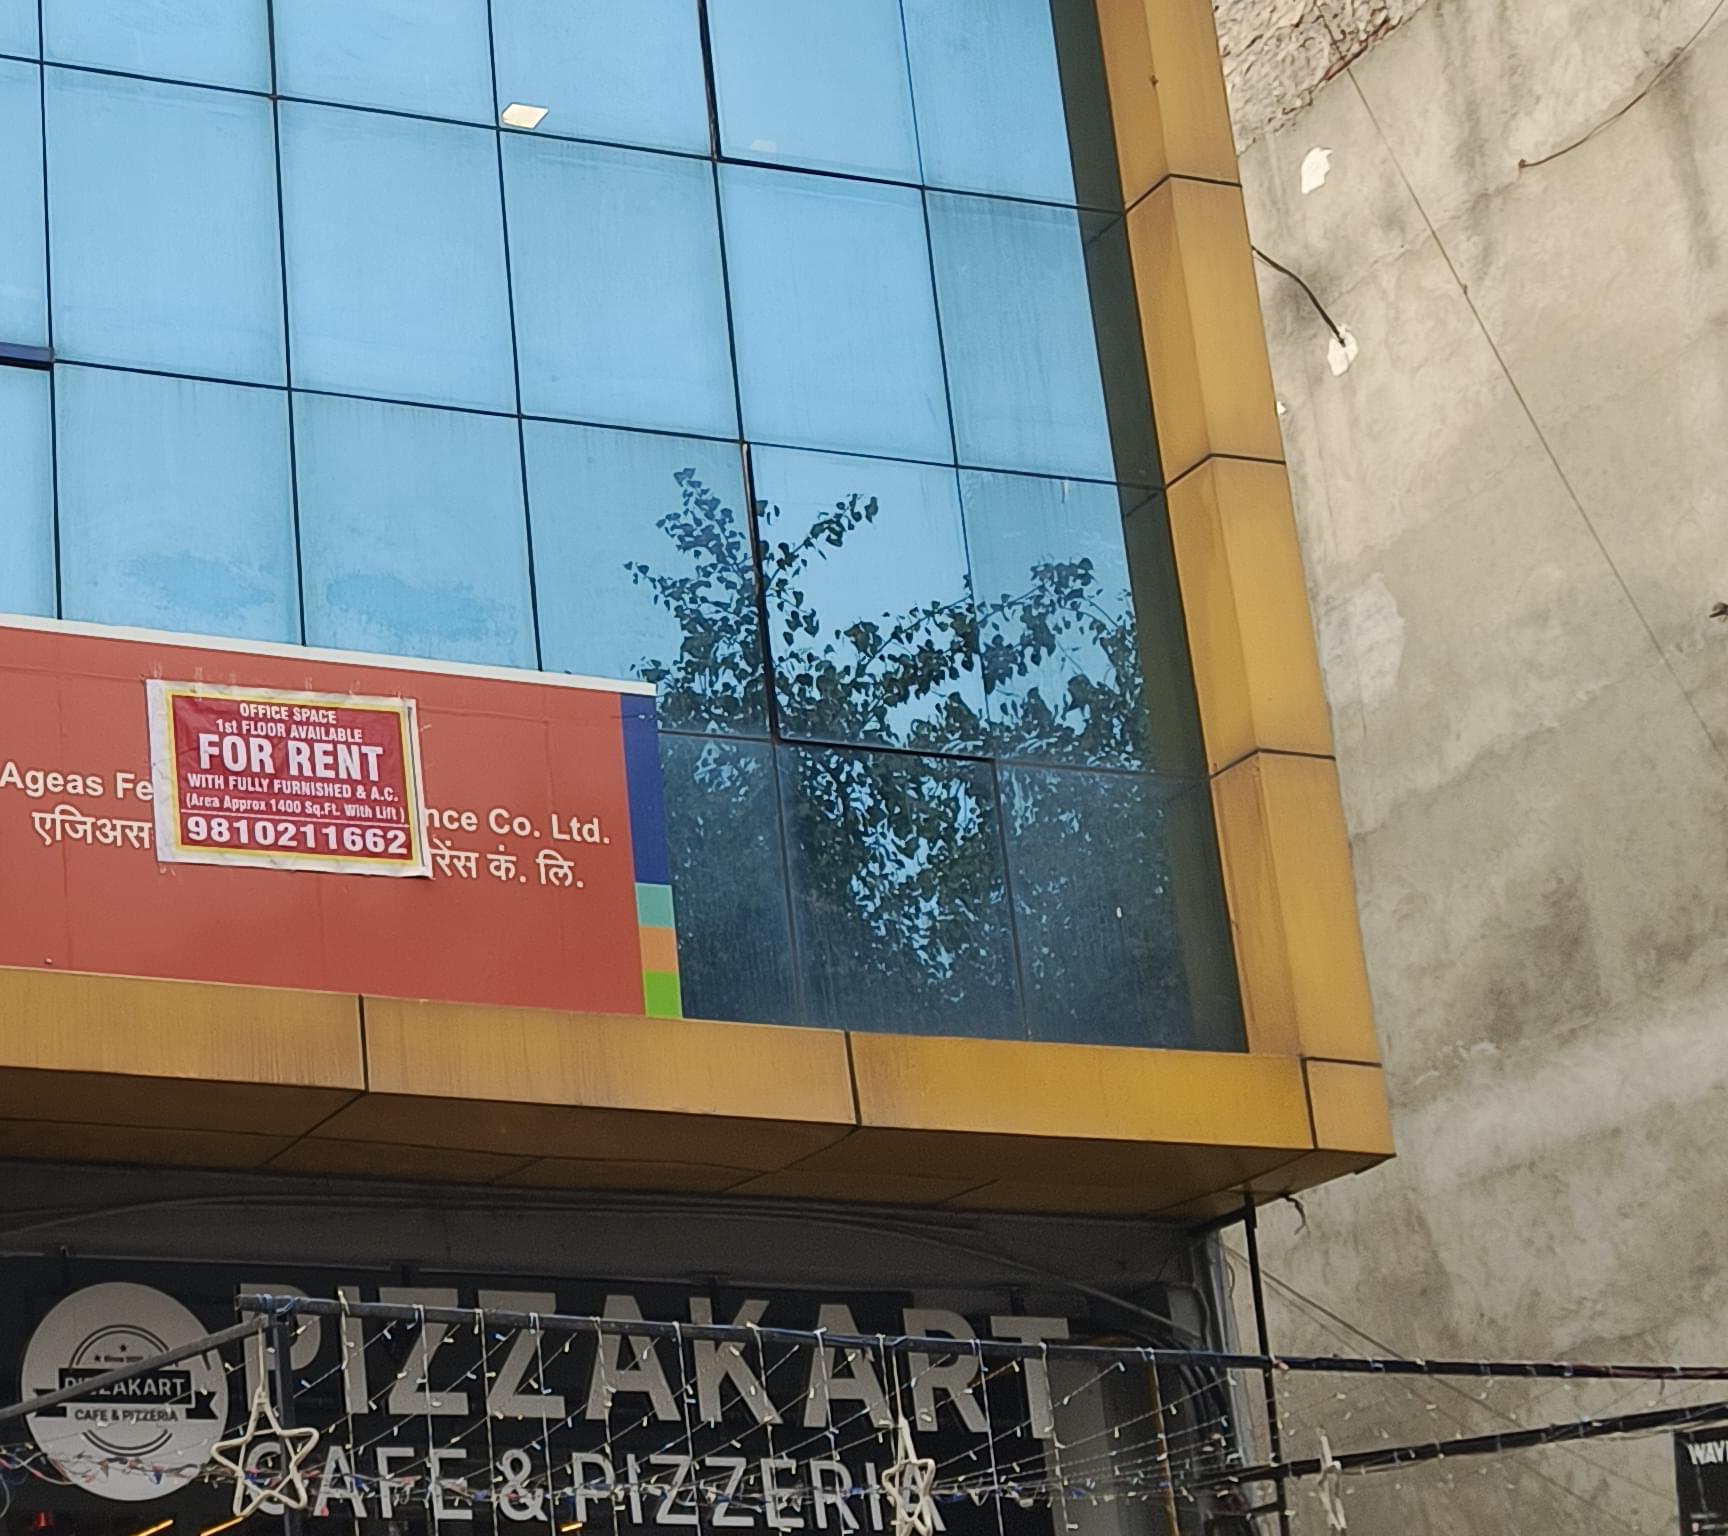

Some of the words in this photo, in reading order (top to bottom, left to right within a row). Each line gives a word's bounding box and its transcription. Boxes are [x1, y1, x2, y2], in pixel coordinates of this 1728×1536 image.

[216, 719, 238, 733] 1st
[242, 720, 286, 738] FLOOR
[290, 725, 363, 743] AVAILABLE
[240, 703, 288, 721] OFFICE
[292, 707, 337, 724] SPACE
[198, 733, 276, 775] FOR
[287, 739, 383, 782] RENT
[187, 773, 224, 790] WITH
[228, 775, 269, 793] FULLY
[273, 779, 352, 799] FURNISHED
[356, 786, 366, 800] &
[370, 786, 400, 802] A.C.
[186, 793, 220, 808] (Area
[223, 795, 266, 813] Approx
[269, 798, 302, 814] 1400
[344, 804, 373, 819] With
[186, 816, 408, 855] 9810211662
[488, 808, 541, 838] Co.
[551, 814, 610, 844] Ltd.
[486, 845, 527, 883] कं.
[536, 849, 584, 888] लि.
[239, 1283, 1070, 1439] PIZZAKART
[75, 1409, 108, 1421] CAFE
[111, 1410, 120, 1421] &
[122, 1409, 178, 1422] PIZZERIA
[244, 1441, 473, 1520] CAFE
[500, 1448, 548, 1522] &
[573, 1452, 946, 1533] PIZZERIA
